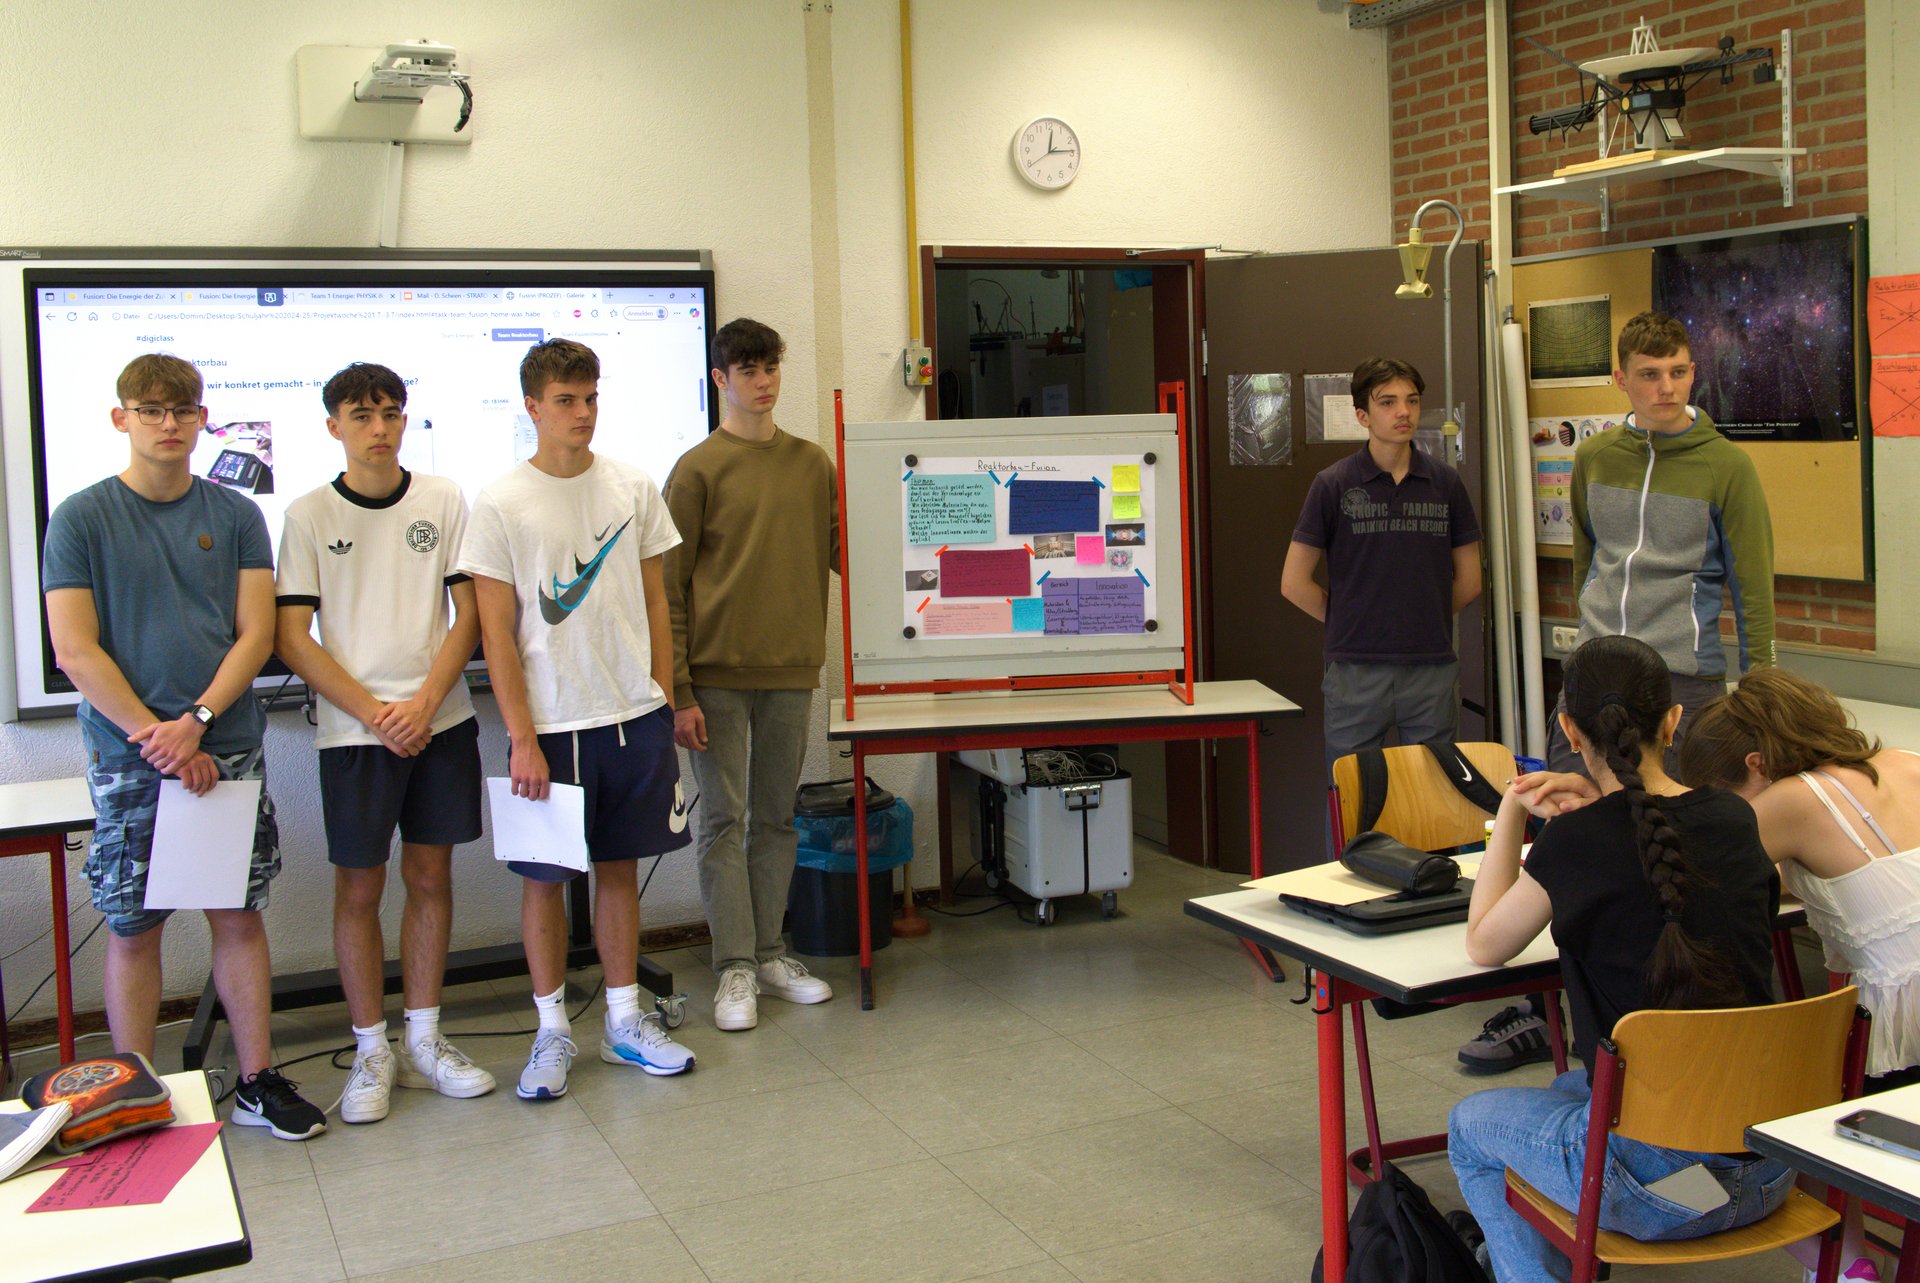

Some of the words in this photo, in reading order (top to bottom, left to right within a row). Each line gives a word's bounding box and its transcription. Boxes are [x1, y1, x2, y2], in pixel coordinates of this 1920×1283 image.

[1035, 125, 1043, 133] 11
[1044, 122, 1054, 131] 12
[1058, 126, 1062, 135] 1
[1026, 134, 1035, 143] 10
[1067, 136, 1073, 145] 2
[1024, 146, 1030, 155] 9
[1069, 150, 1075, 158] 3
[1026, 159, 1032, 168] 8
[1047, 173, 1053, 182] 6
[1058, 170, 1064, 179] 5
[119, 293, 141, 302] Energie
[627, 310, 654, 318] Anmelden
[136, 334, 175, 345] #digiclass
[224, 381, 261, 389] konkret
[263, 380, 304, 391] gemacht
[313, 380, 322, 388] in
[1403, 502, 1449, 518] PARADISE
[1352, 519, 1388, 534] WAIKIKI
[1390, 518, 1418, 532] BEACH
[1420, 520, 1449, 534] RESORT
[1095, 580, 1129, 590] Innovation
